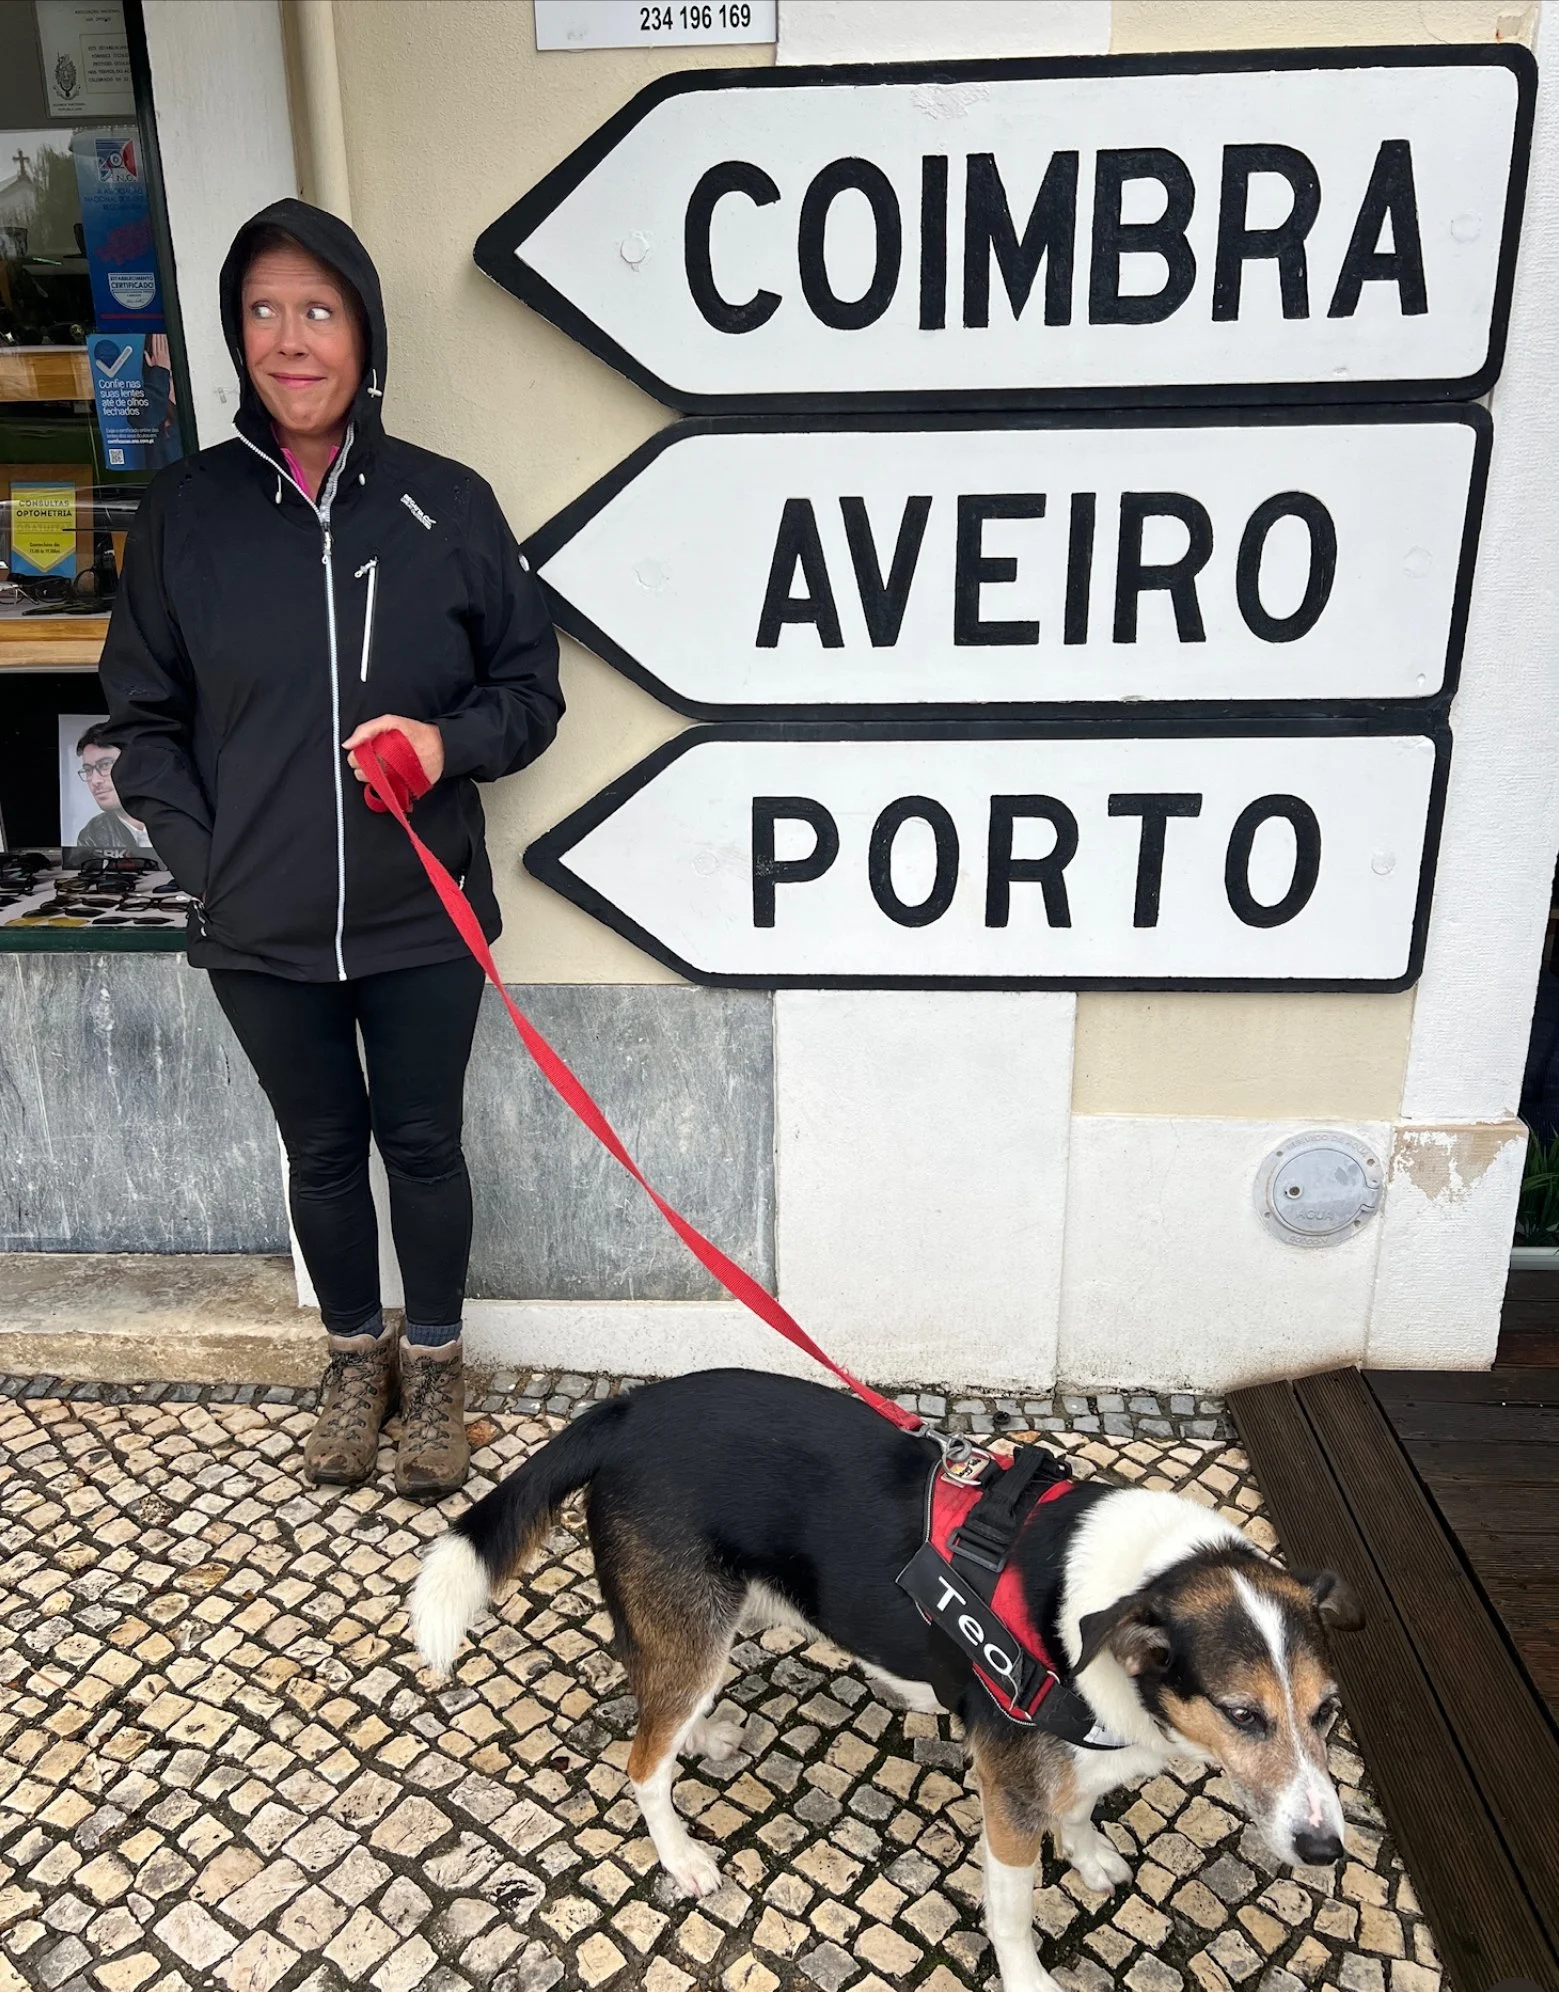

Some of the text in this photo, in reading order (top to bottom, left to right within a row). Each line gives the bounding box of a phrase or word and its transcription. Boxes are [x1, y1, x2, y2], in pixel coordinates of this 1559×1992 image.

[640, 3, 751, 31] 234 196 169
[685, 139, 1429, 335] COIMBRA
[110, 281, 154, 289] CERTIFICADO
[98, 378, 141, 389] Confie nas
[100, 389, 145, 398] suas lentes
[101, 398, 149, 407] até de olhos
[102, 406, 141, 416] fechados
[19, 499, 70, 507] CONSULTAS
[16, 509, 72, 517] OPTOMETRIA
[756, 491, 1338, 649] AVEIRO
[752, 793, 1322, 929] PORTO
[936, 1575, 1013, 1677] Teo
